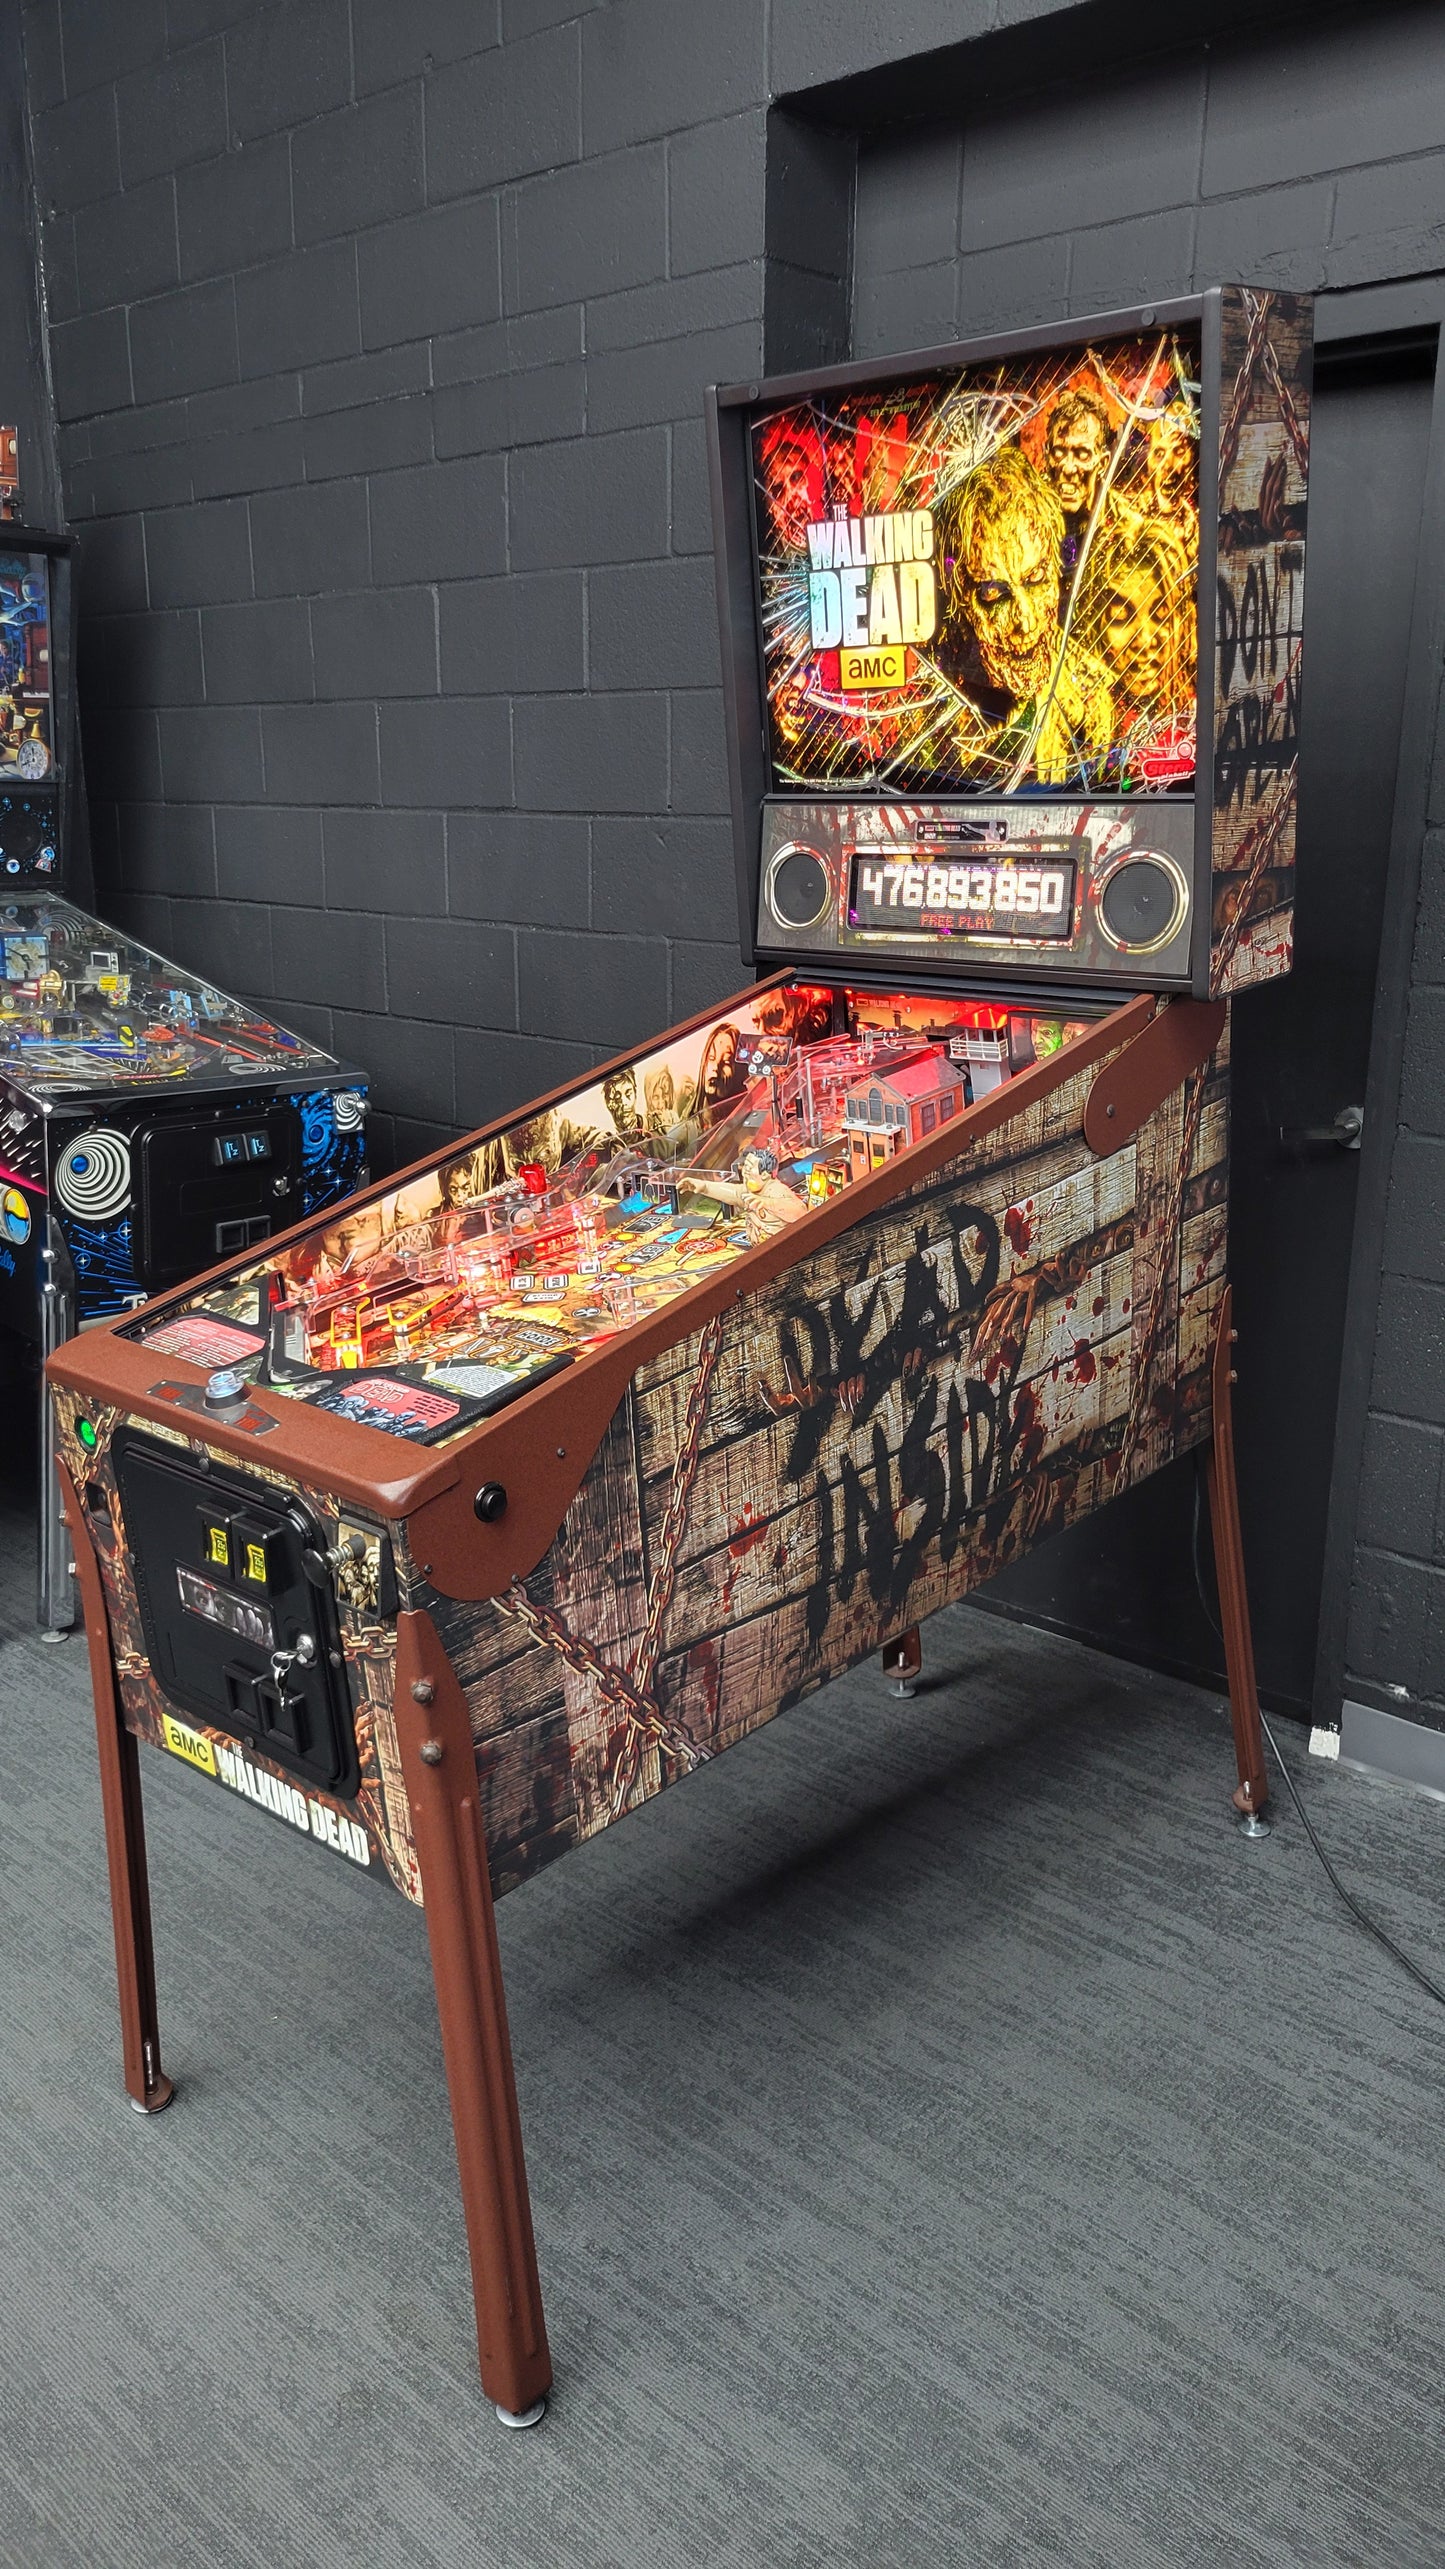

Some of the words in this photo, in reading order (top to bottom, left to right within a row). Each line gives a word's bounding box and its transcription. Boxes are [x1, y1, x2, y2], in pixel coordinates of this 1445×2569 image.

[807, 510, 934, 570] WALKING
[832, 504, 848, 521] THE
[809, 561, 936, 650] DEAD
[920, 913, 954, 928] FREE
[957, 915, 994, 930] PLAY
[519, 1331, 560, 1346] HORDE
[775, 1203, 1002, 1480] DEAD
[213, 1743, 310, 1832] WALKING
[308, 1798, 371, 1867] DEAD
